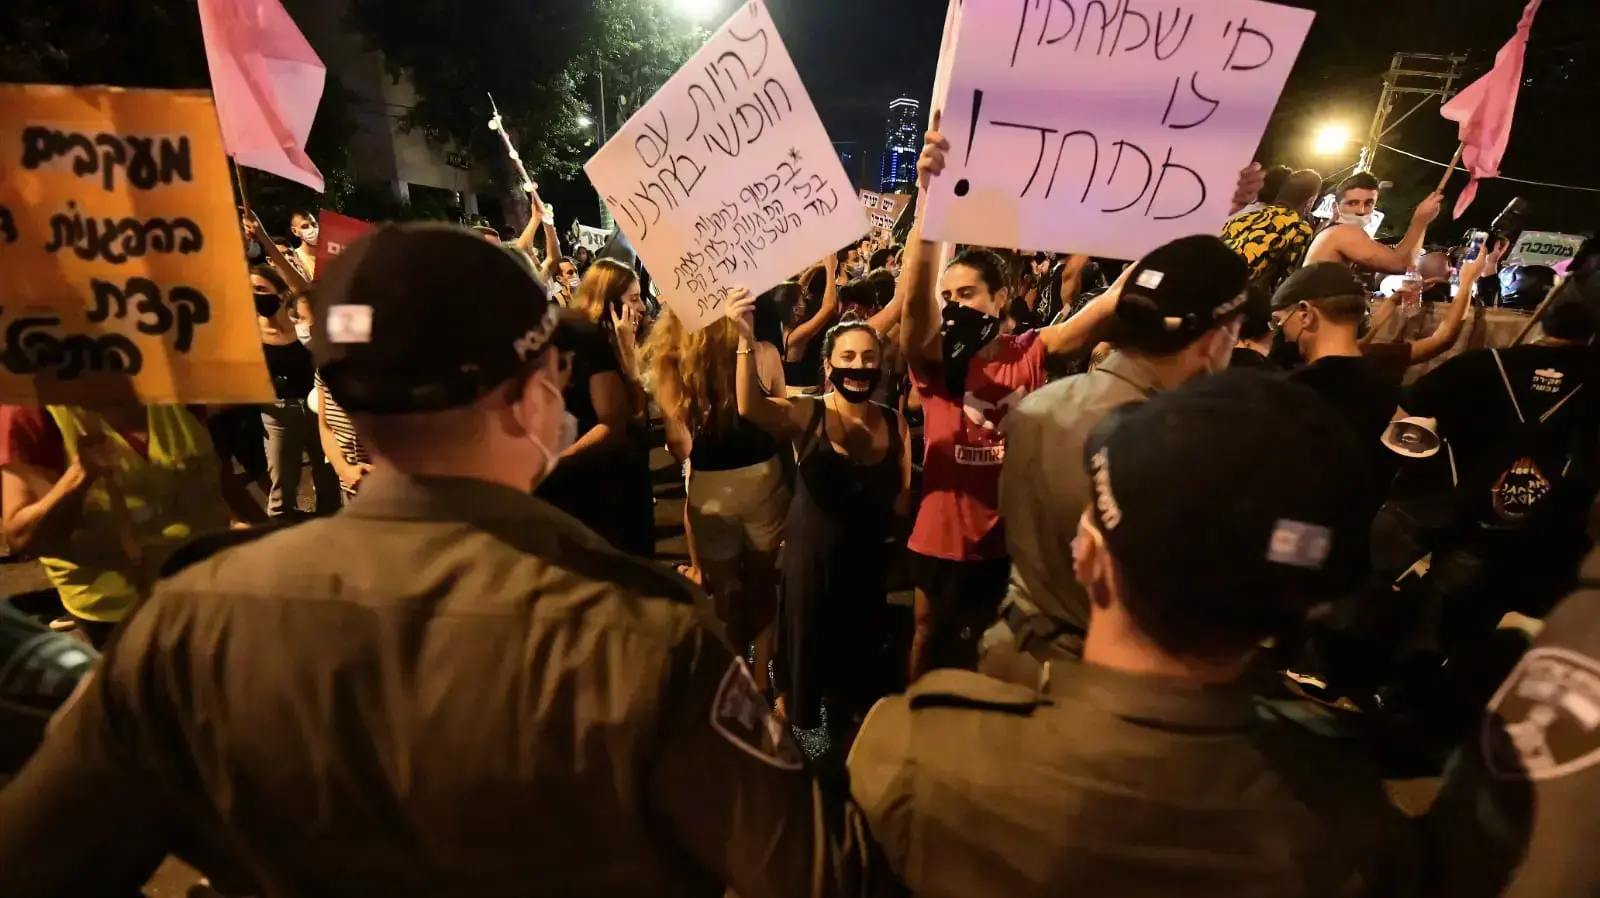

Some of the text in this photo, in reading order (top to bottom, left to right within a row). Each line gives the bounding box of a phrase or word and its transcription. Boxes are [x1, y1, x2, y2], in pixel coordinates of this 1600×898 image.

[1010, 0, 1274, 71] מי שמאמין
[702, 78, 792, 157] חופשי
[1161, 71, 1219, 129] לו
[21, 126, 192, 191] מעקבים
[635, 110, 669, 168] עם
[803, 187, 839, 217] נגד
[703, 237, 729, 261] לא
[706, 264, 718, 284] 1
[715, 253, 738, 276] עד
[1519, 242, 1574, 257] מהפכה
[87, 277, 210, 354] קצת
